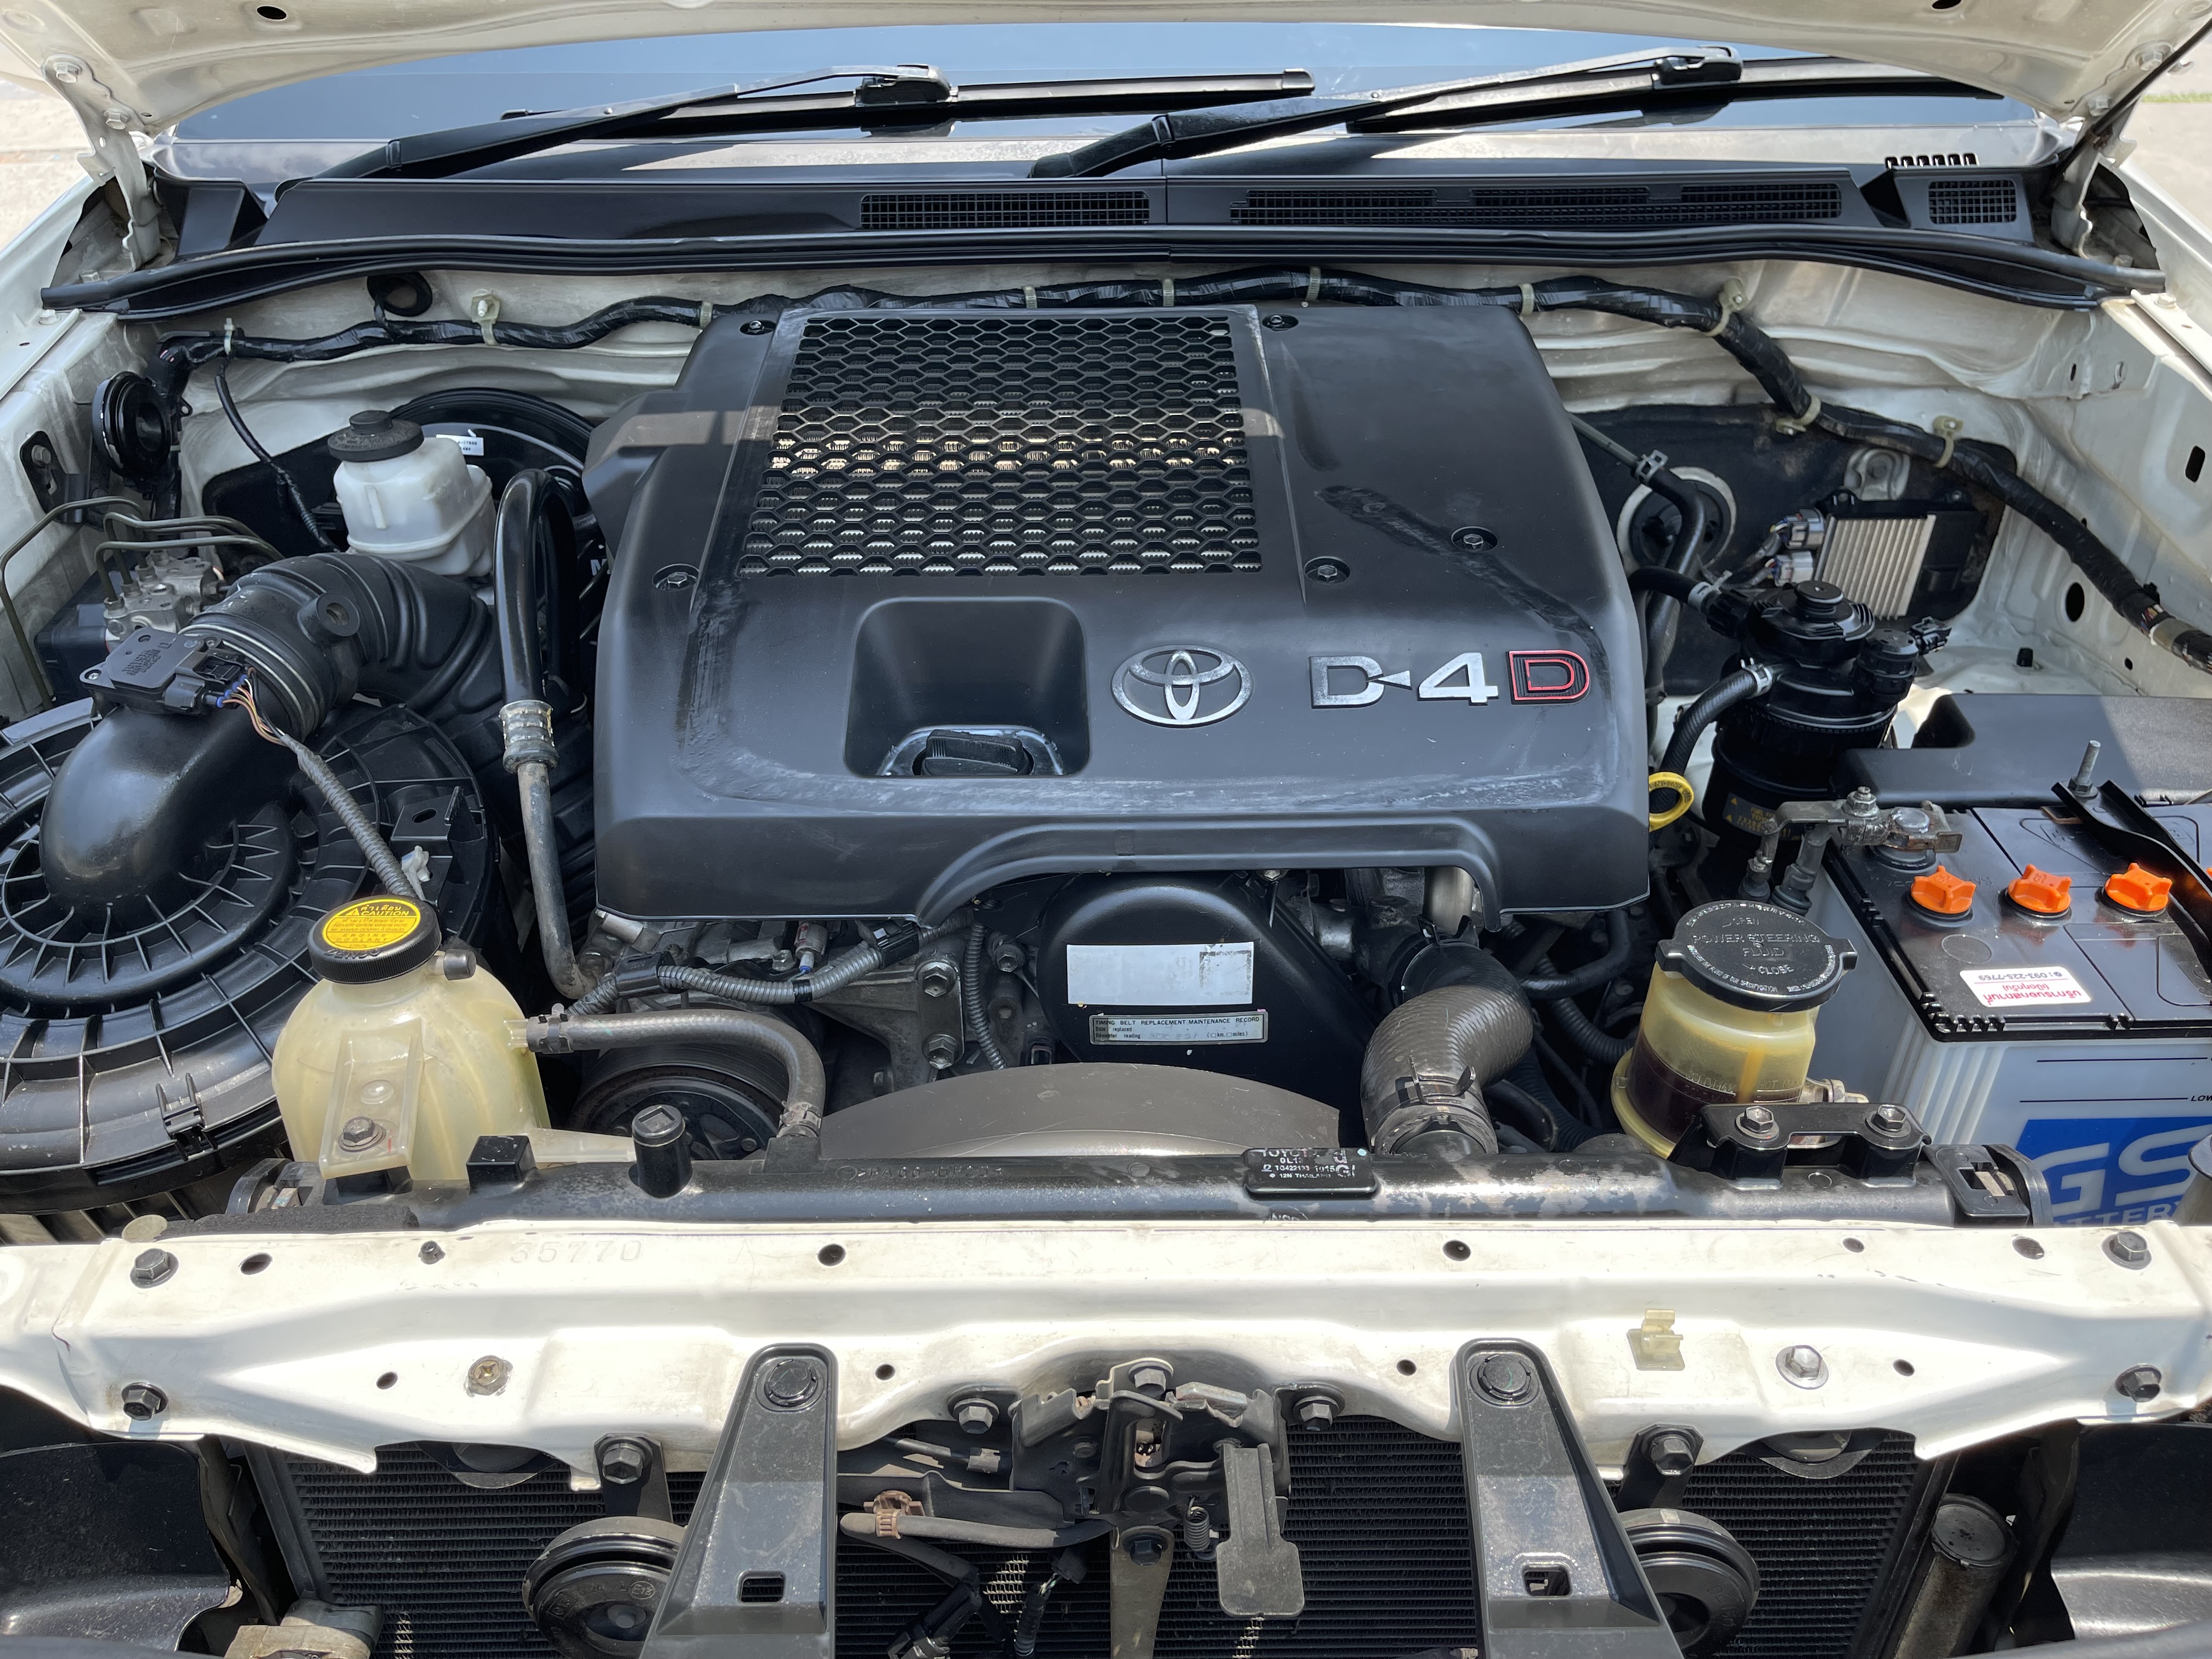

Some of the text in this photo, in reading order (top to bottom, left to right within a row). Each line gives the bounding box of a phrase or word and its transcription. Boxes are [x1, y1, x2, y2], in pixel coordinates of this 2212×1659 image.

[1308, 650, 1590, 708] D-4D
[1692, 933, 1821, 944] POWER STEERING
[1741, 947, 1785, 957] FLUID
[1757, 964, 1795, 975] CLOSE
[1978, 972, 2048, 981] 093-225-7769
[1982, 990, 2082, 1005] บริการนอกสถานที่
[510, 1240, 641, 1263] 35770
